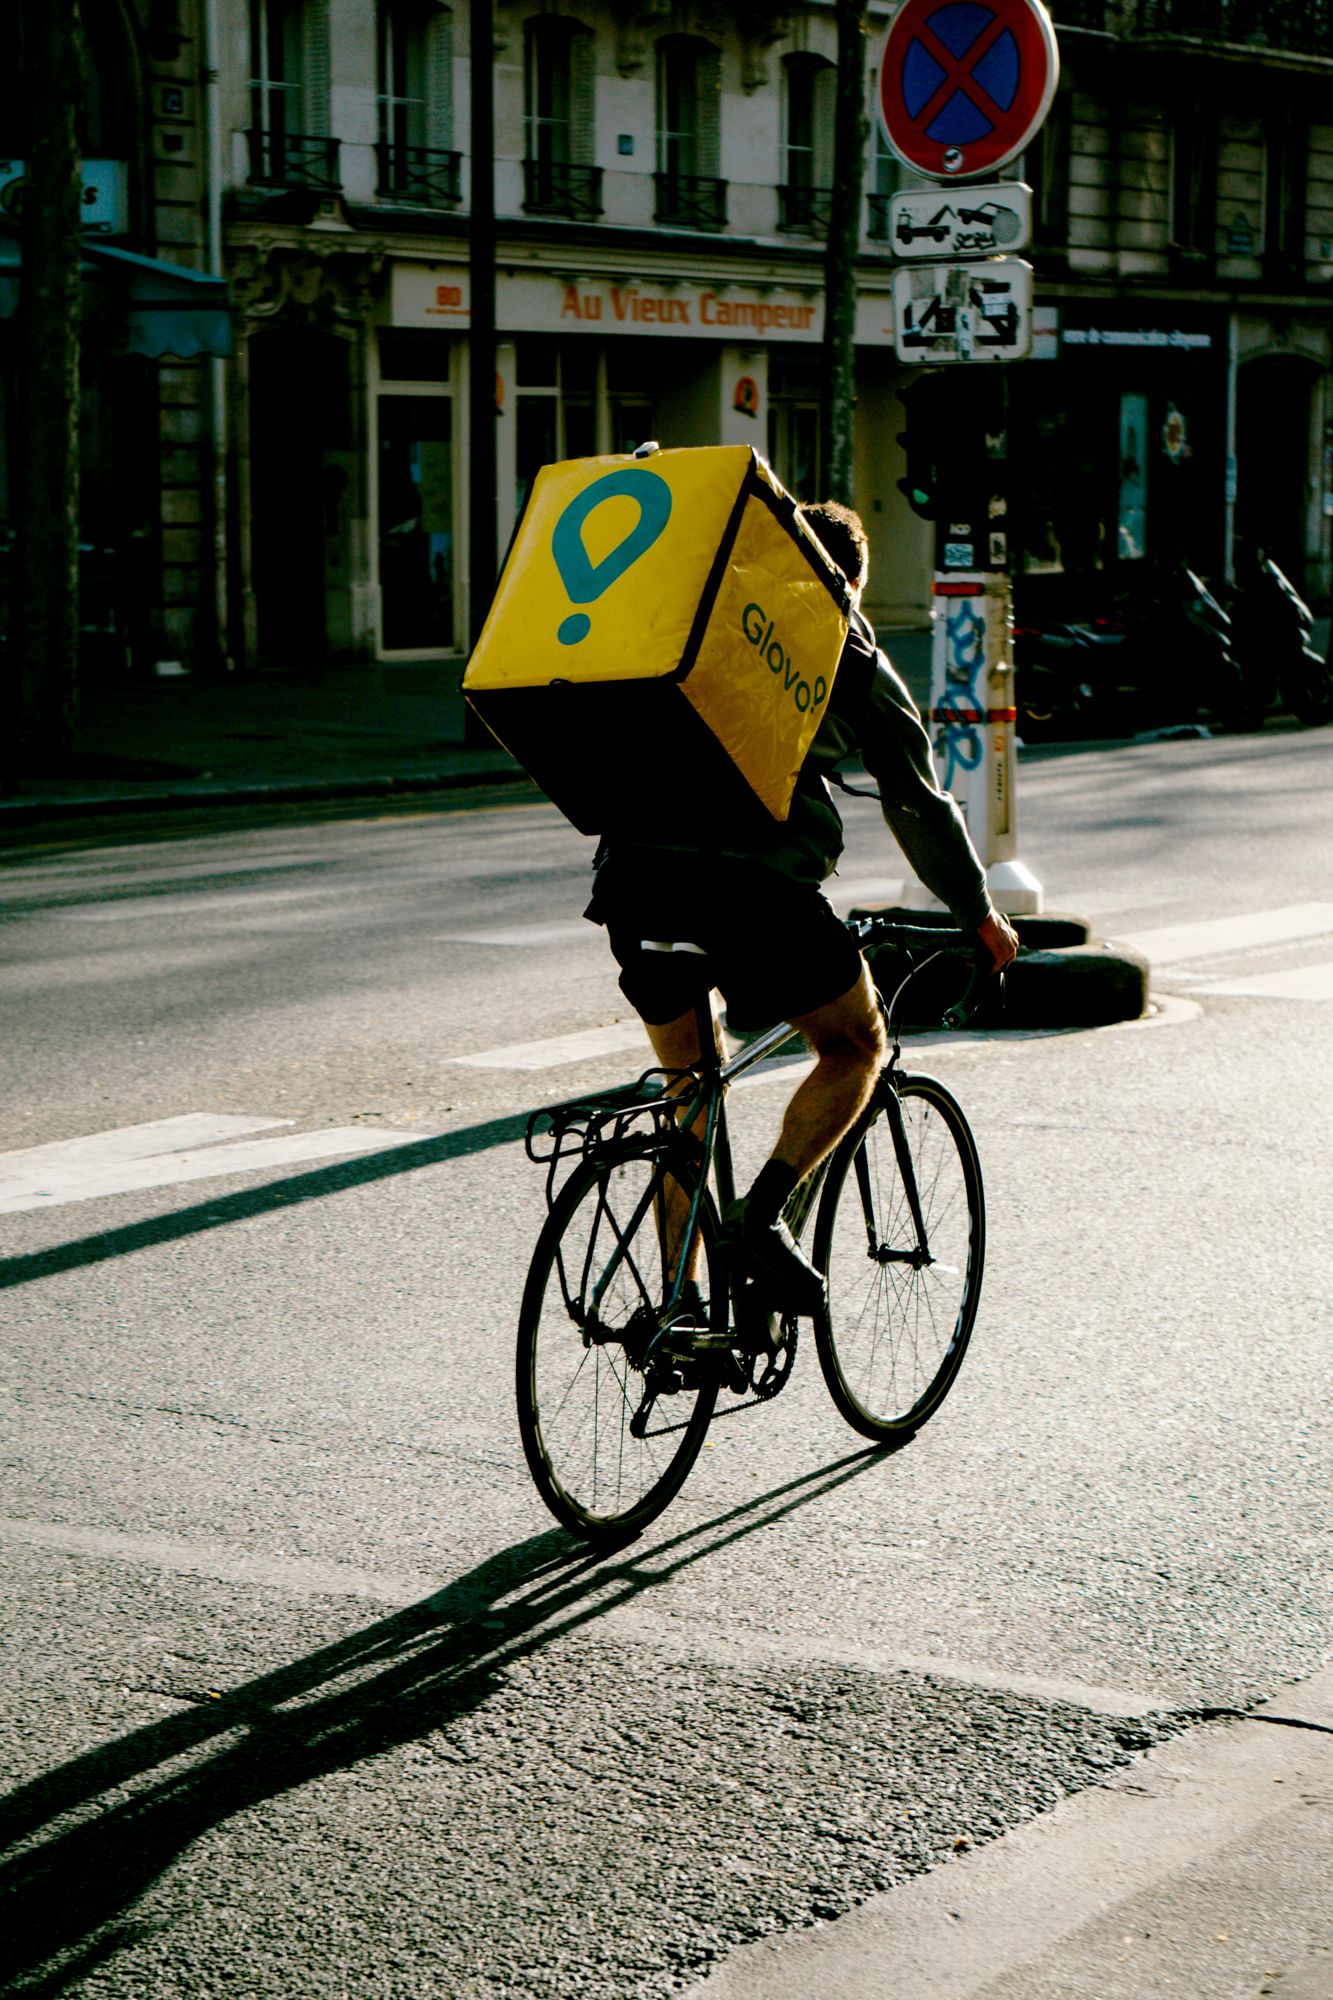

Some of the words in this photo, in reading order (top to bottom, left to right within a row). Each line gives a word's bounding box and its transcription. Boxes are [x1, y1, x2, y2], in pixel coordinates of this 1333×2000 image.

[561, 283, 601, 320] Au
[610, 287, 690, 324] Vieux
[700, 292, 815, 336] Campeur
